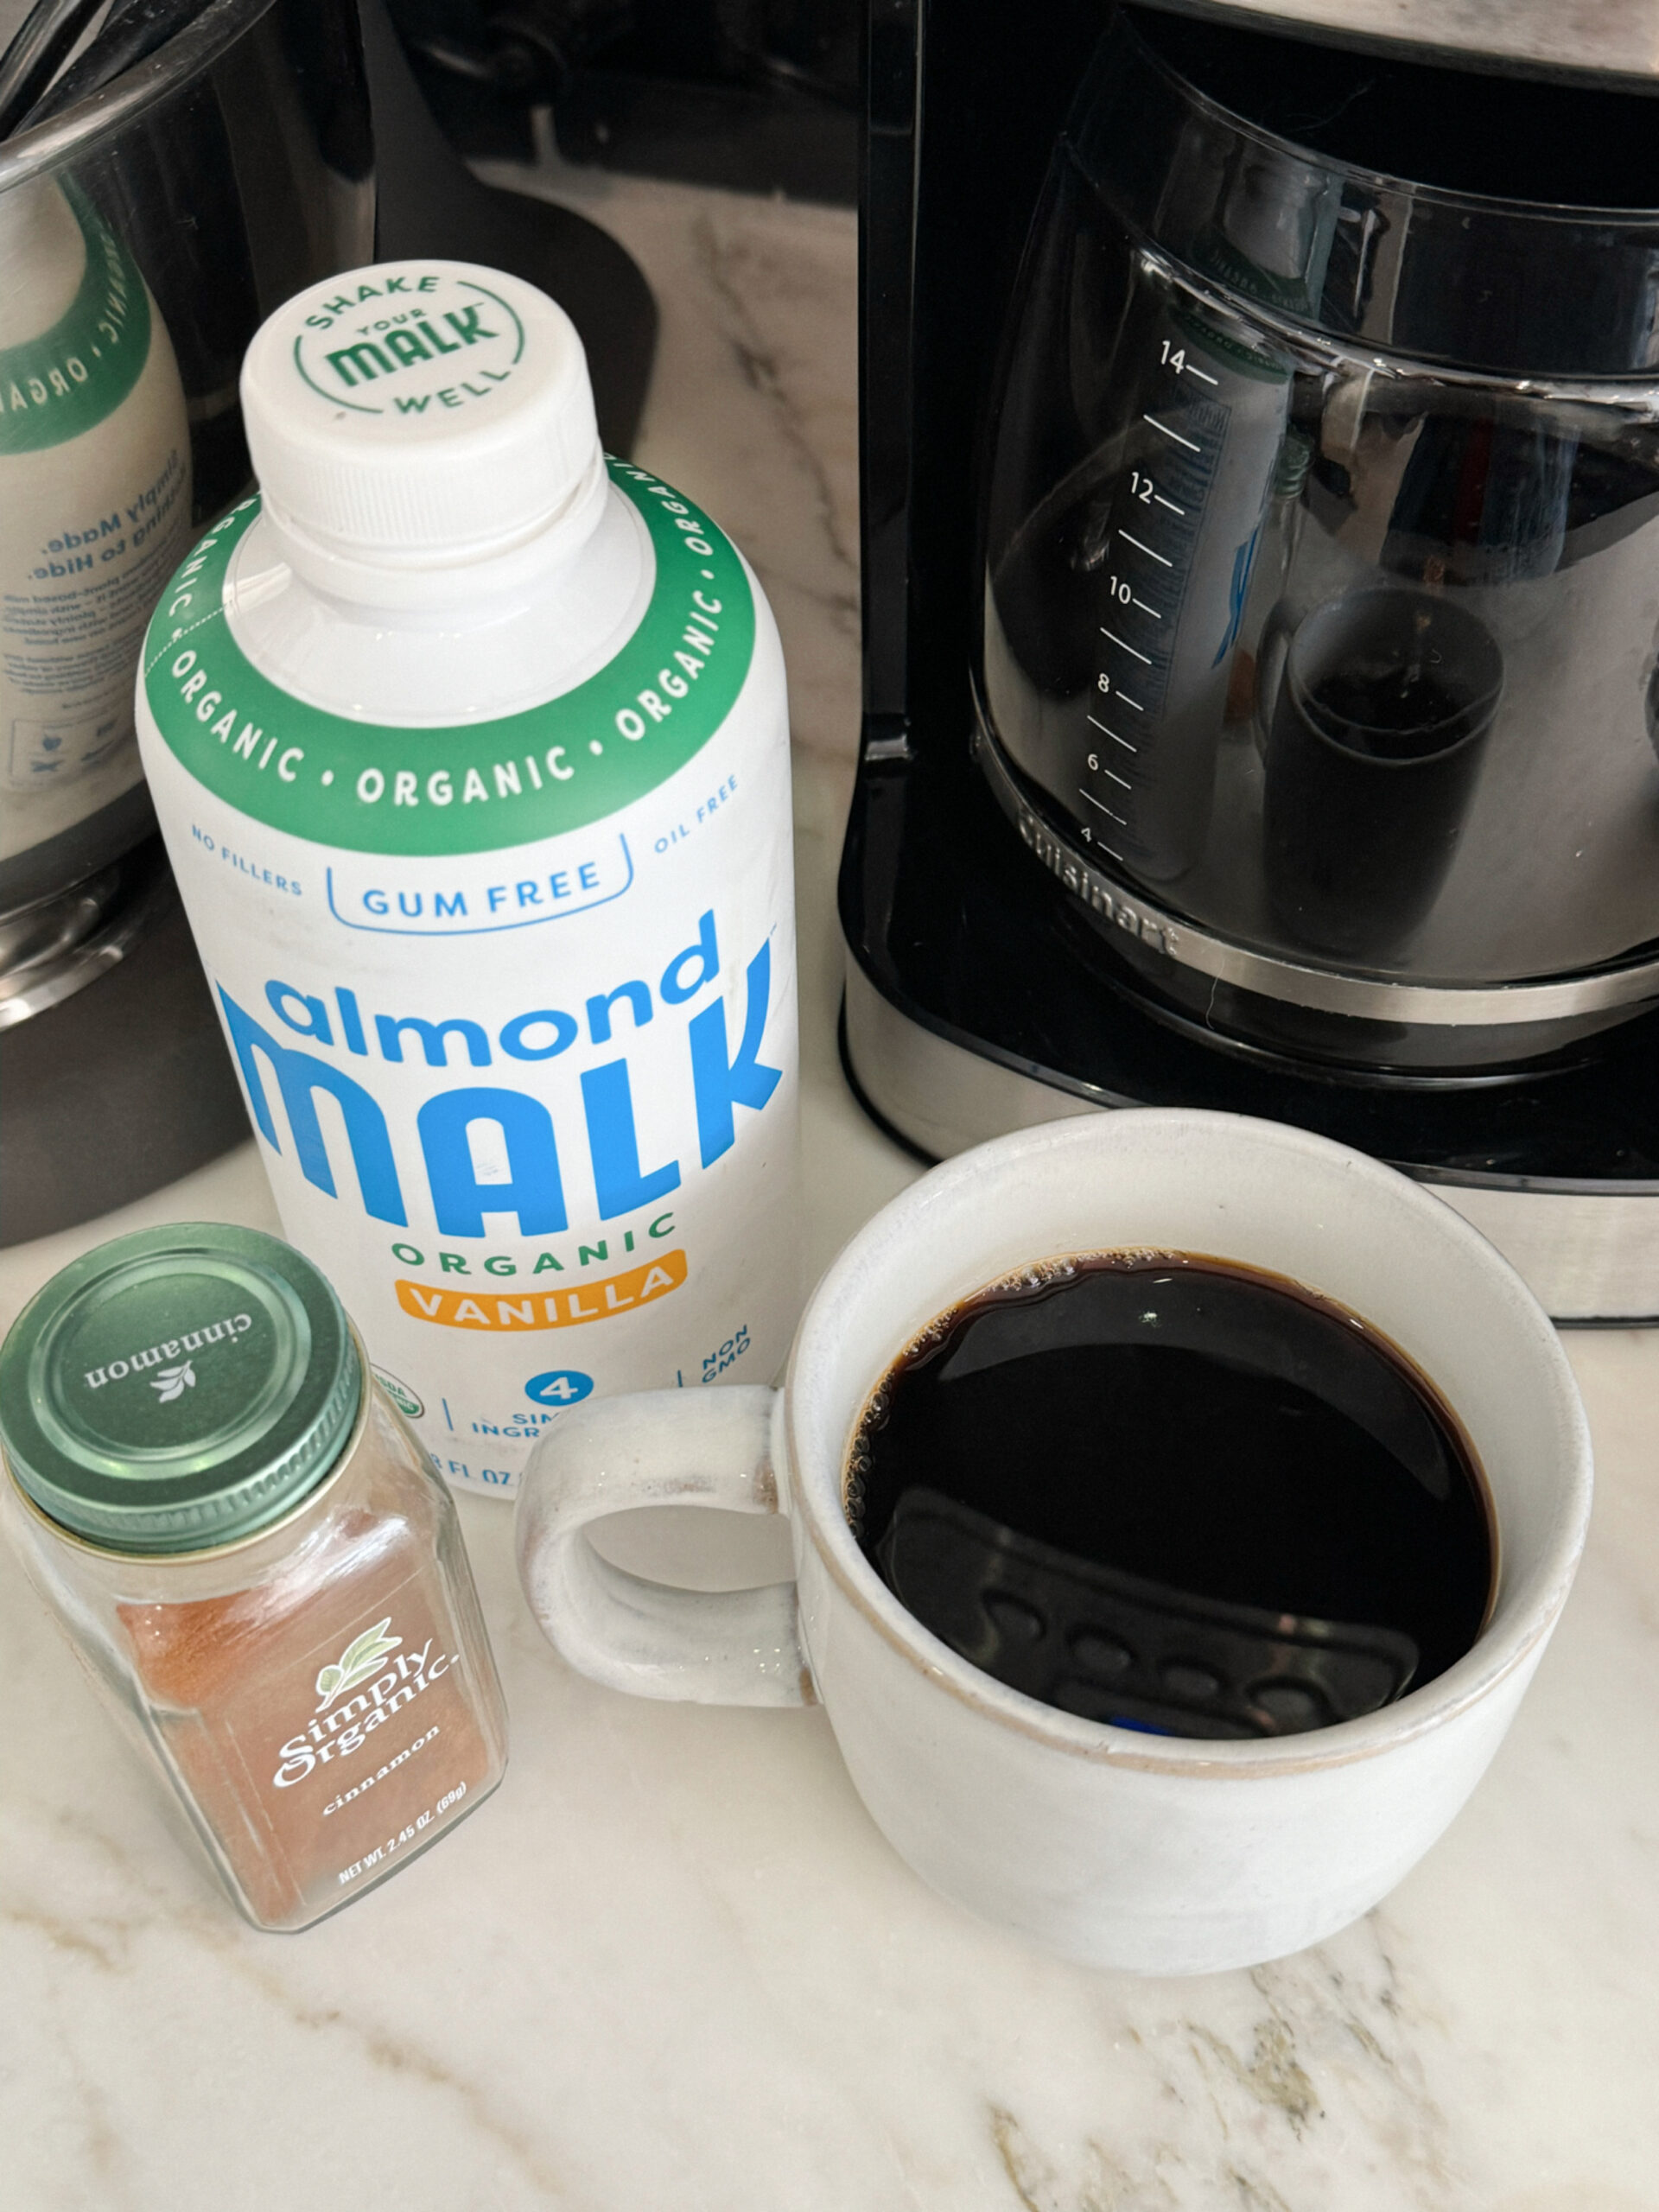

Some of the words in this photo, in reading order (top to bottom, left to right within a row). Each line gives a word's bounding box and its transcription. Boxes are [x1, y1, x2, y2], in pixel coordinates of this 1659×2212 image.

[305, 276, 440, 330] SHAKE
[356, 308, 427, 336] YOUR
[323, 305, 500, 387] MALK
[1160, 340, 1187, 375] 14
[393, 365, 512, 415] WELL
[1130, 472, 1154, 504] 12
[168, 490, 262, 617] RGANIC
[1109, 575, 1133, 605] 10
[615, 590, 722, 741] ORGANIC
[1096, 673, 1111, 694] 8
[171, 649, 304, 784] ORGANIC
[357, 746, 575, 808] ORGANIC
[1086, 753, 1100, 772] 6
[653, 822, 690, 855] OIL
[696, 774, 739, 825] FREE
[191, 823, 215, 853] NO
[221, 849, 303, 897] FILLERS
[362, 887, 468, 919] GUM
[486, 861, 601, 912] FREE
[264, 908, 720, 1067] almond
[215, 938, 783, 1238] MALK
[391, 1211, 677, 1276] ORGANIC
[410, 1266, 675, 1325] VANILLA
[84, 1312, 253, 1391] cinnamon
[701, 1324, 748, 1370] NON
[701, 1337, 752, 1384] GMO
[539, 1376, 579, 1400] 4
[278, 1637, 433, 1759] Simply
[322, 1726, 441, 1816] cinnamon
[338, 1862, 362, 1885] NET
[386, 1825, 416, 1853] 2.45
[435, 1780, 467, 1815] (69g)
